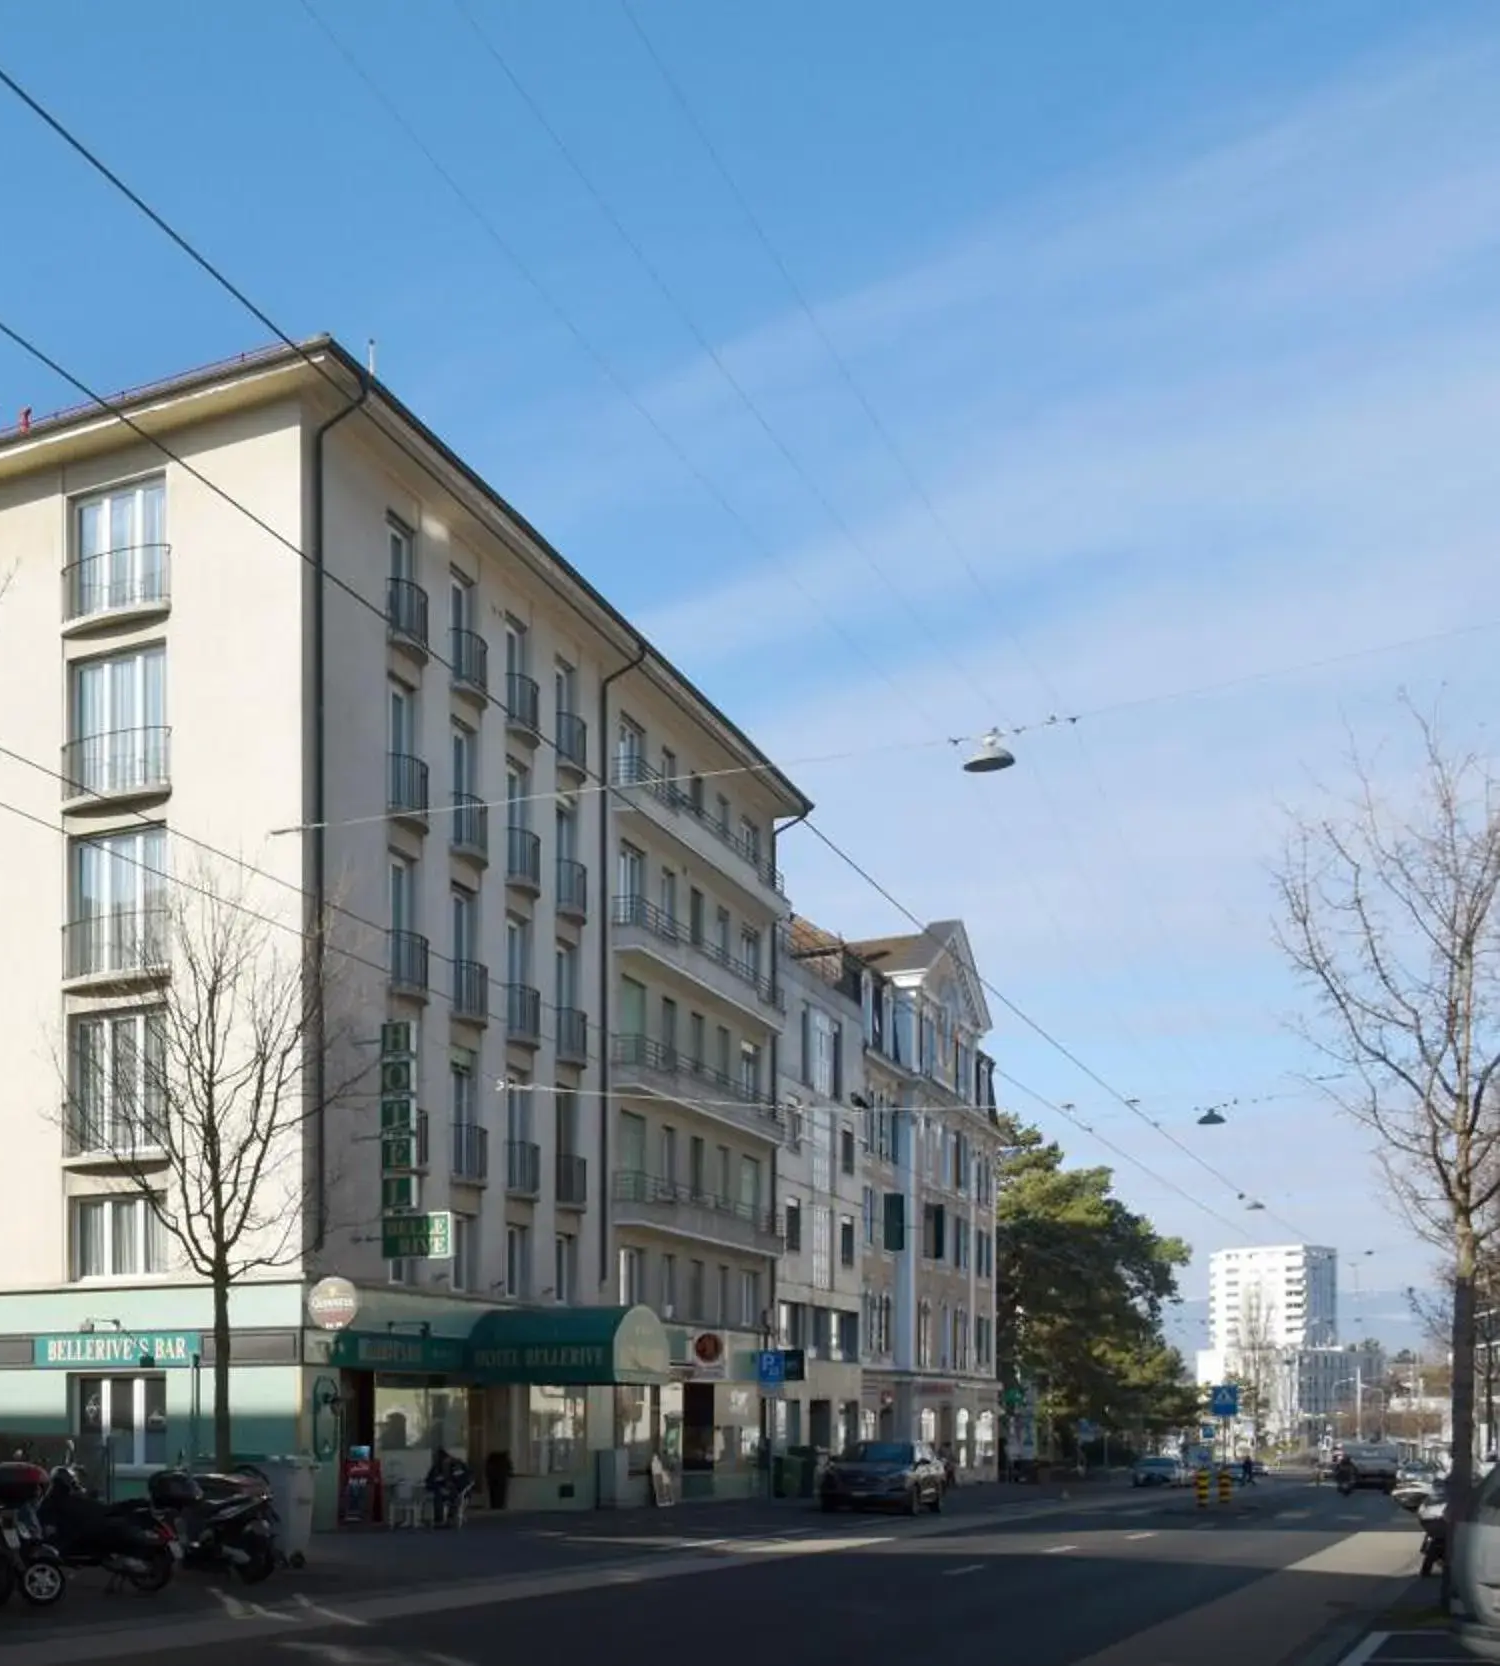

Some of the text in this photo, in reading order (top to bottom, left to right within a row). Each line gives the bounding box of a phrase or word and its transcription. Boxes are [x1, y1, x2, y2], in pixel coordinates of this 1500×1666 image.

[384, 1024, 410, 1207] HOTEL
[47, 1336, 186, 1361] BELLERIVE'S BAR
